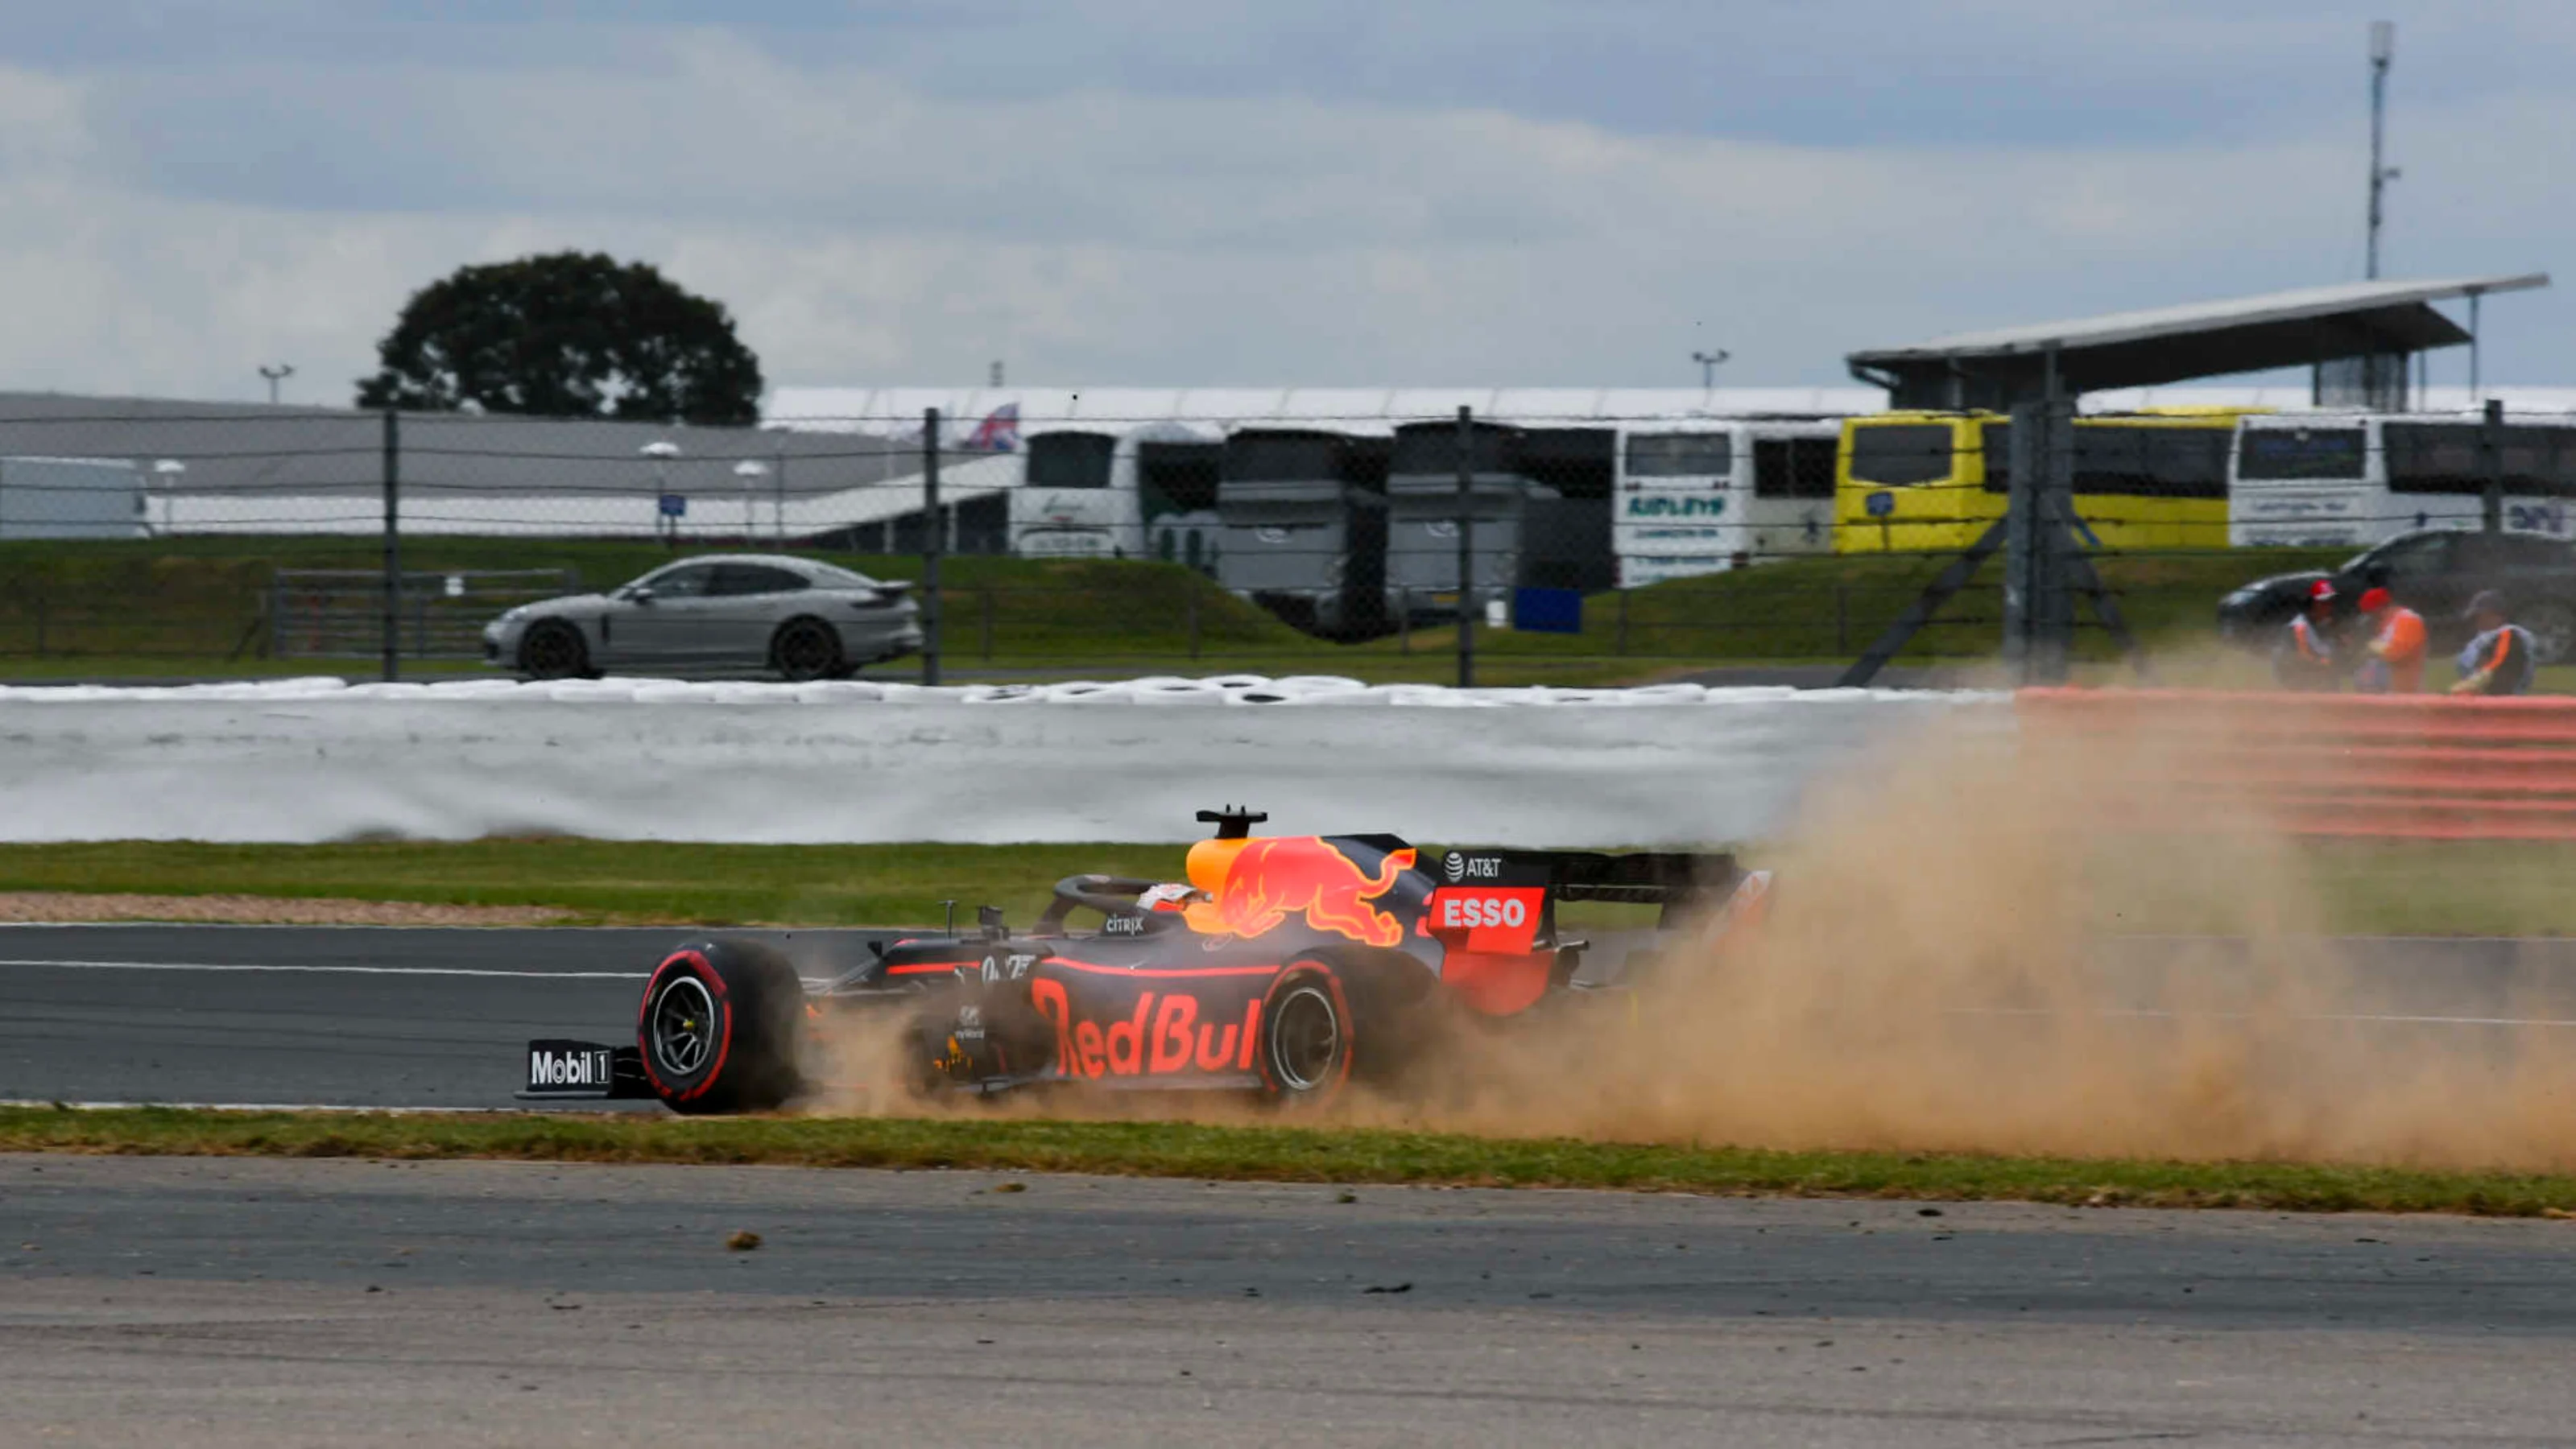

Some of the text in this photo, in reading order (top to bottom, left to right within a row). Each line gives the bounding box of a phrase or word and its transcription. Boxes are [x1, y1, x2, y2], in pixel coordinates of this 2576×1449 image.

[1466, 857, 1502, 877] AT&T
[1445, 898, 1525, 928] ESSO
[531, 1051, 592, 1084] Mobil
